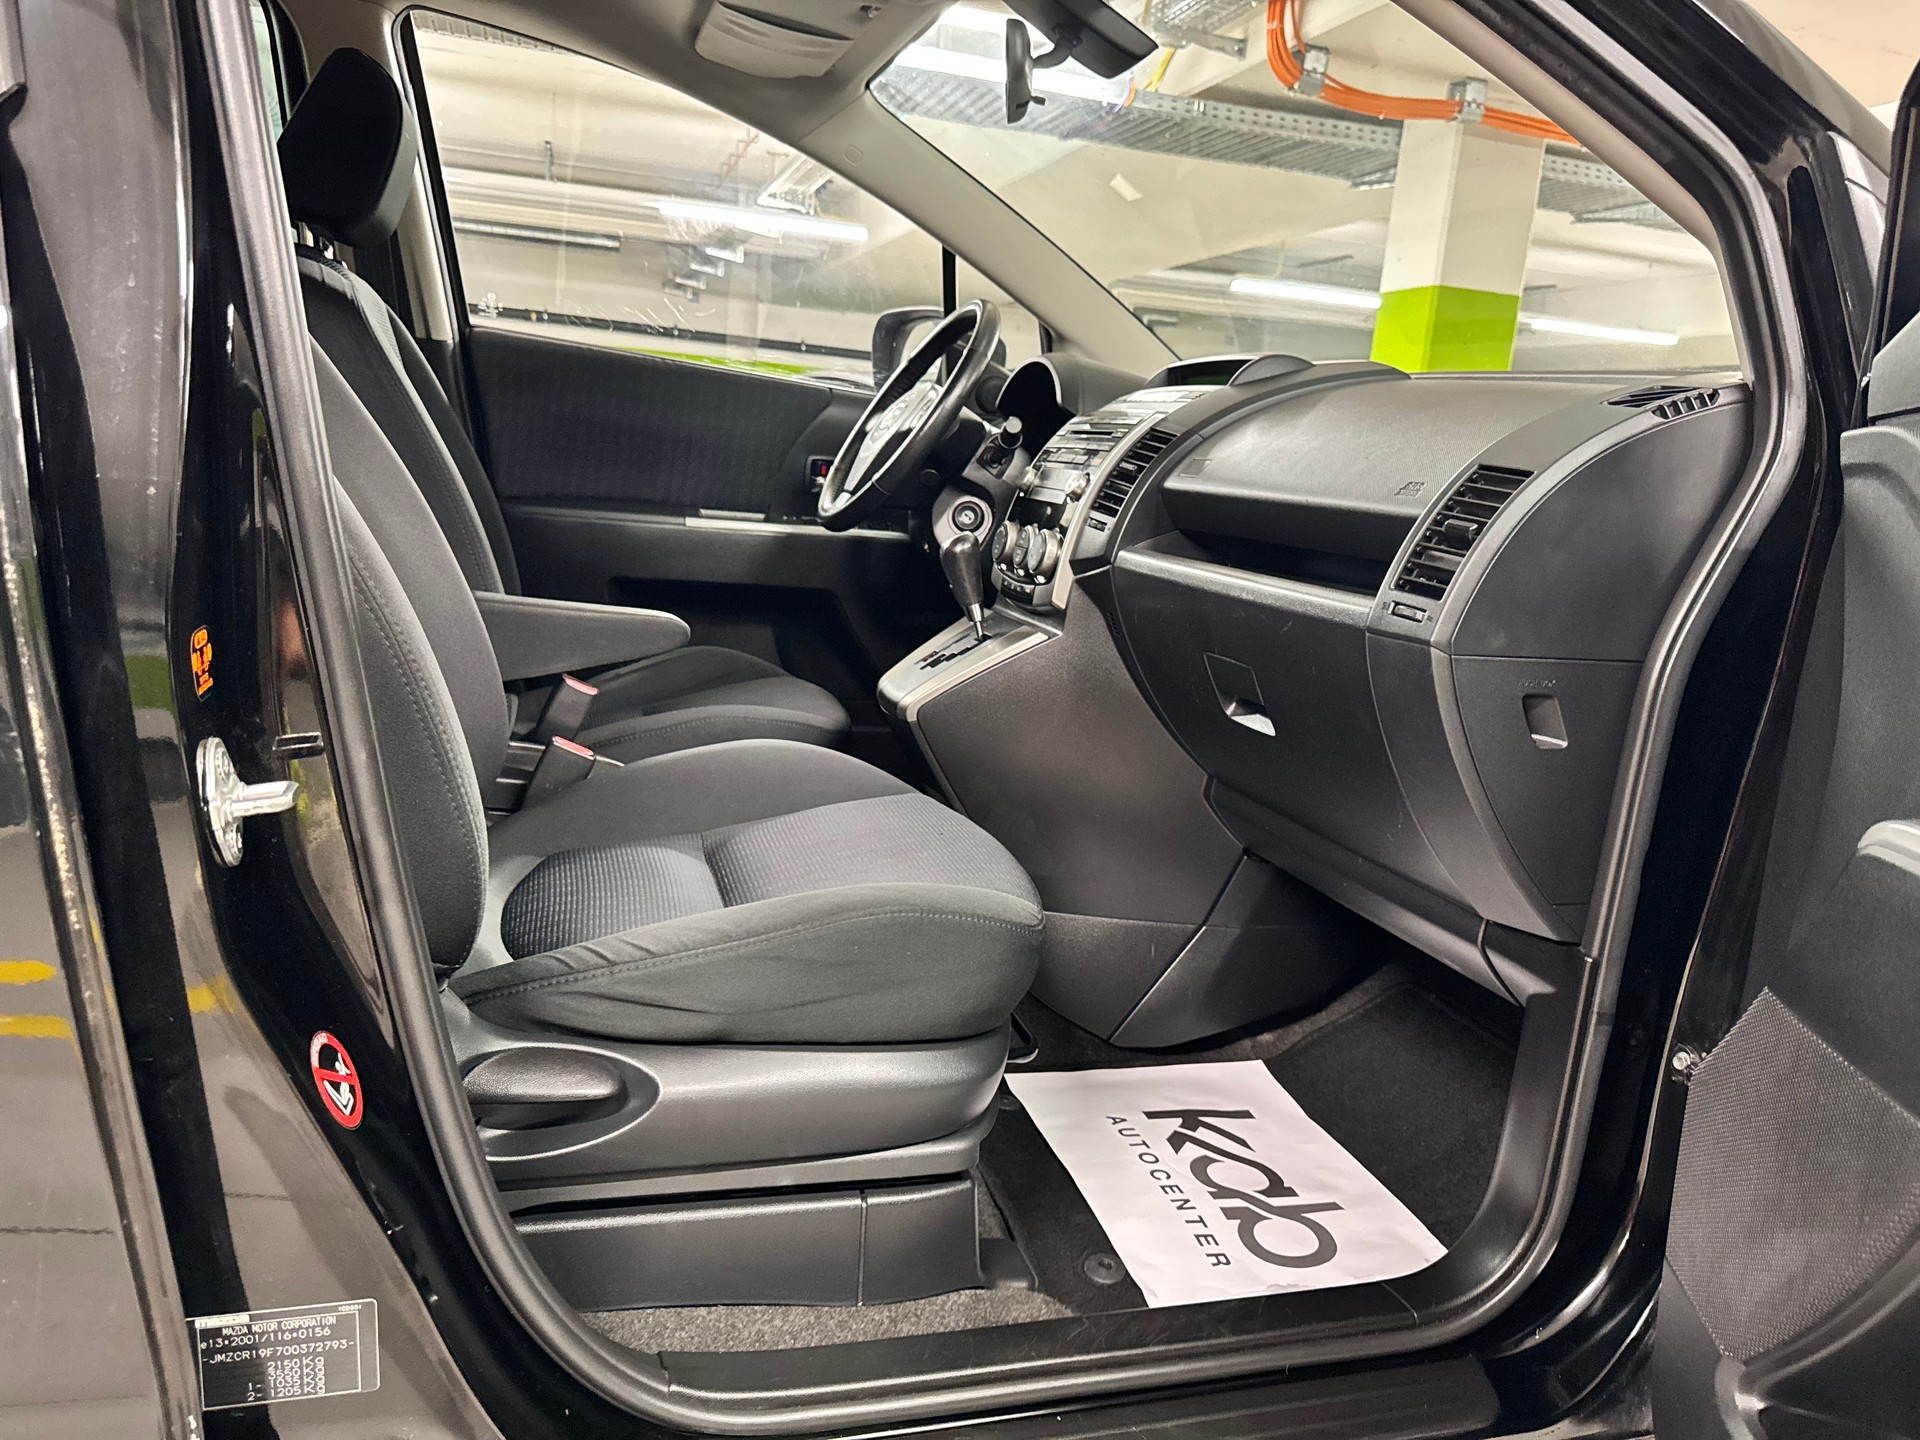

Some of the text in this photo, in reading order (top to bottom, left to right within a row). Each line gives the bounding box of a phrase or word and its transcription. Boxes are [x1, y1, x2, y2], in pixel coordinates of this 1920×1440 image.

[1105, 1114, 1231, 1269] AUTOCENTER
[222, 1325, 248, 1336] MAZDA
[251, 1322, 278, 1333] MOTOR
[281, 1315, 337, 1330] CORPORATION
[267, 1355, 325, 1371] 2150 Kg
[268, 1365, 325, 1380] 3550 Kg
[270, 1376, 301, 1388] 1035
[303, 1374, 326, 1386] Kg
[271, 1386, 301, 1397] 1205
[304, 1383, 326, 1395] Kg
